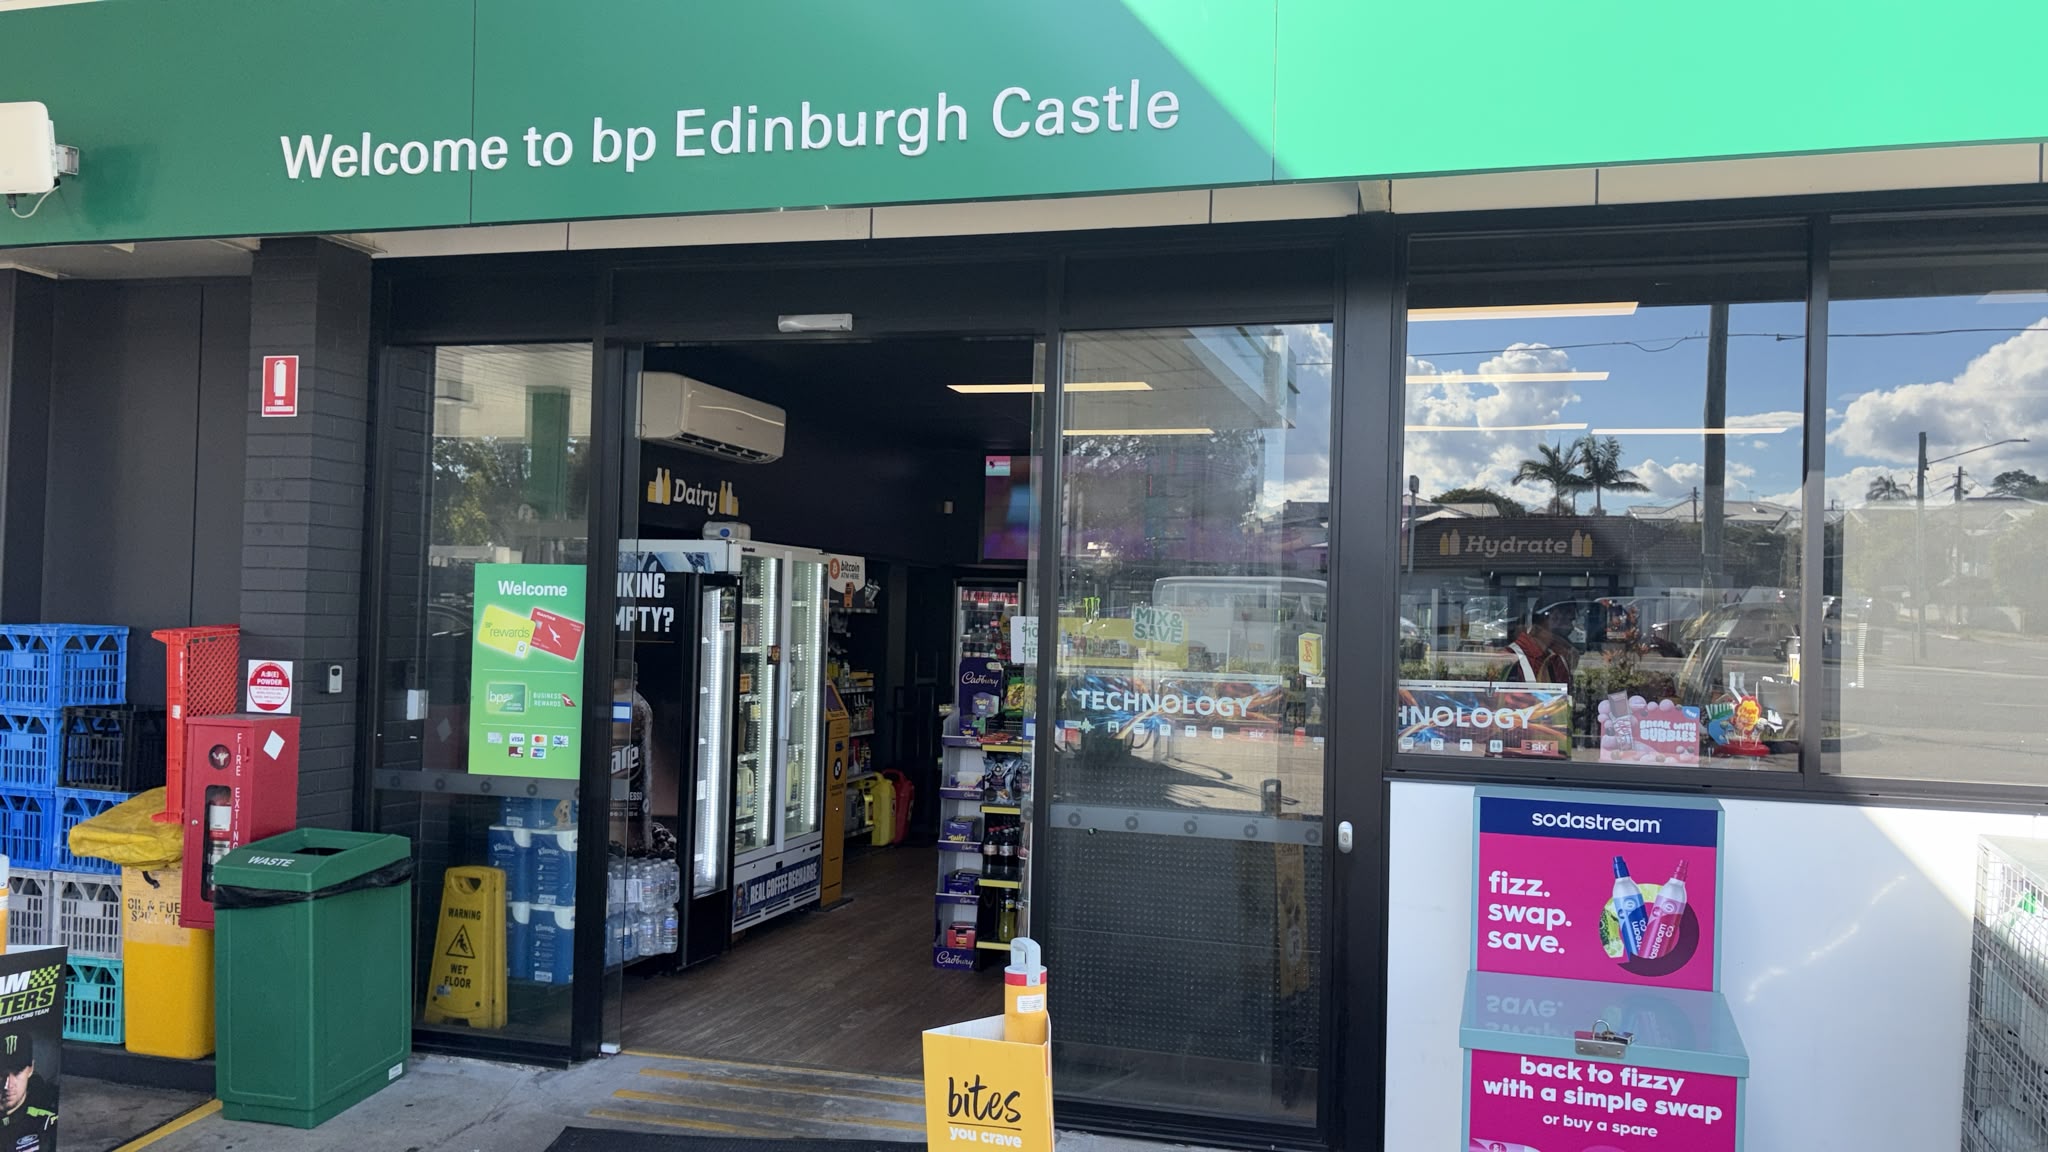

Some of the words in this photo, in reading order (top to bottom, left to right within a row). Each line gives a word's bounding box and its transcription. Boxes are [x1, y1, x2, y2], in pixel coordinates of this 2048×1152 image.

[280, 132, 509, 180] Welcome
[523, 126, 574, 168] to
[592, 116, 656, 172] bp
[675, 92, 968, 157] Edinburgh
[992, 79, 1181, 139] Castle
[673, 478, 718, 515] Dairy
[1465, 535, 1568, 558] Hydrate
[841, 560, 860, 572] bitcoin
[497, 580, 568, 597] Welcome
[489, 626, 530, 638] rewards
[1134, 623, 1183, 644] SAVE
[256, 678, 283, 686] POWDER
[961, 671, 999, 688] Cadbury
[533, 691, 562, 700] BUSINESS
[534, 700, 561, 708] REWARDS
[1076, 689, 1254, 718] TECHNOLOGY
[1639, 727, 1697, 743] BUBBLES
[1673, 721, 1697, 732] WITH
[1531, 811, 1661, 834] sodastream
[247, 854, 296, 869] WASTE
[750, 880, 766, 906] REAL
[766, 873, 788, 899] COFFEE
[1488, 870, 1551, 898] fizz.
[448, 907, 481, 921] WARNING
[1488, 902, 1572, 931] swap.
[1487, 929, 1566, 954] save.
[450, 963, 469, 976] WET
[936, 950, 974, 969] Cadbury
[444, 975, 472, 989] FLOOR
[12, 1011, 35, 1022] RACING
[34, 1007, 50, 1017] TEAM
[1520, 1056, 1582, 1082] back
[1588, 1063, 1614, 1084] to
[1620, 1066, 1685, 1096] fizzy
[947, 1074, 1022, 1123] bites
[1483, 1077, 1534, 1100] with
[1540, 1086, 1557, 1102] a
[1563, 1086, 1648, 1114] simple
[1654, 1095, 1723, 1125] swap
[1542, 1114, 1560, 1126] or
[1563, 1114, 1593, 1132] buy
[1596, 1120, 1608, 1131] a
[1611, 1122, 1658, 1138] spare
[949, 1126, 977, 1141] you
[981, 1131, 1023, 1149] crave
